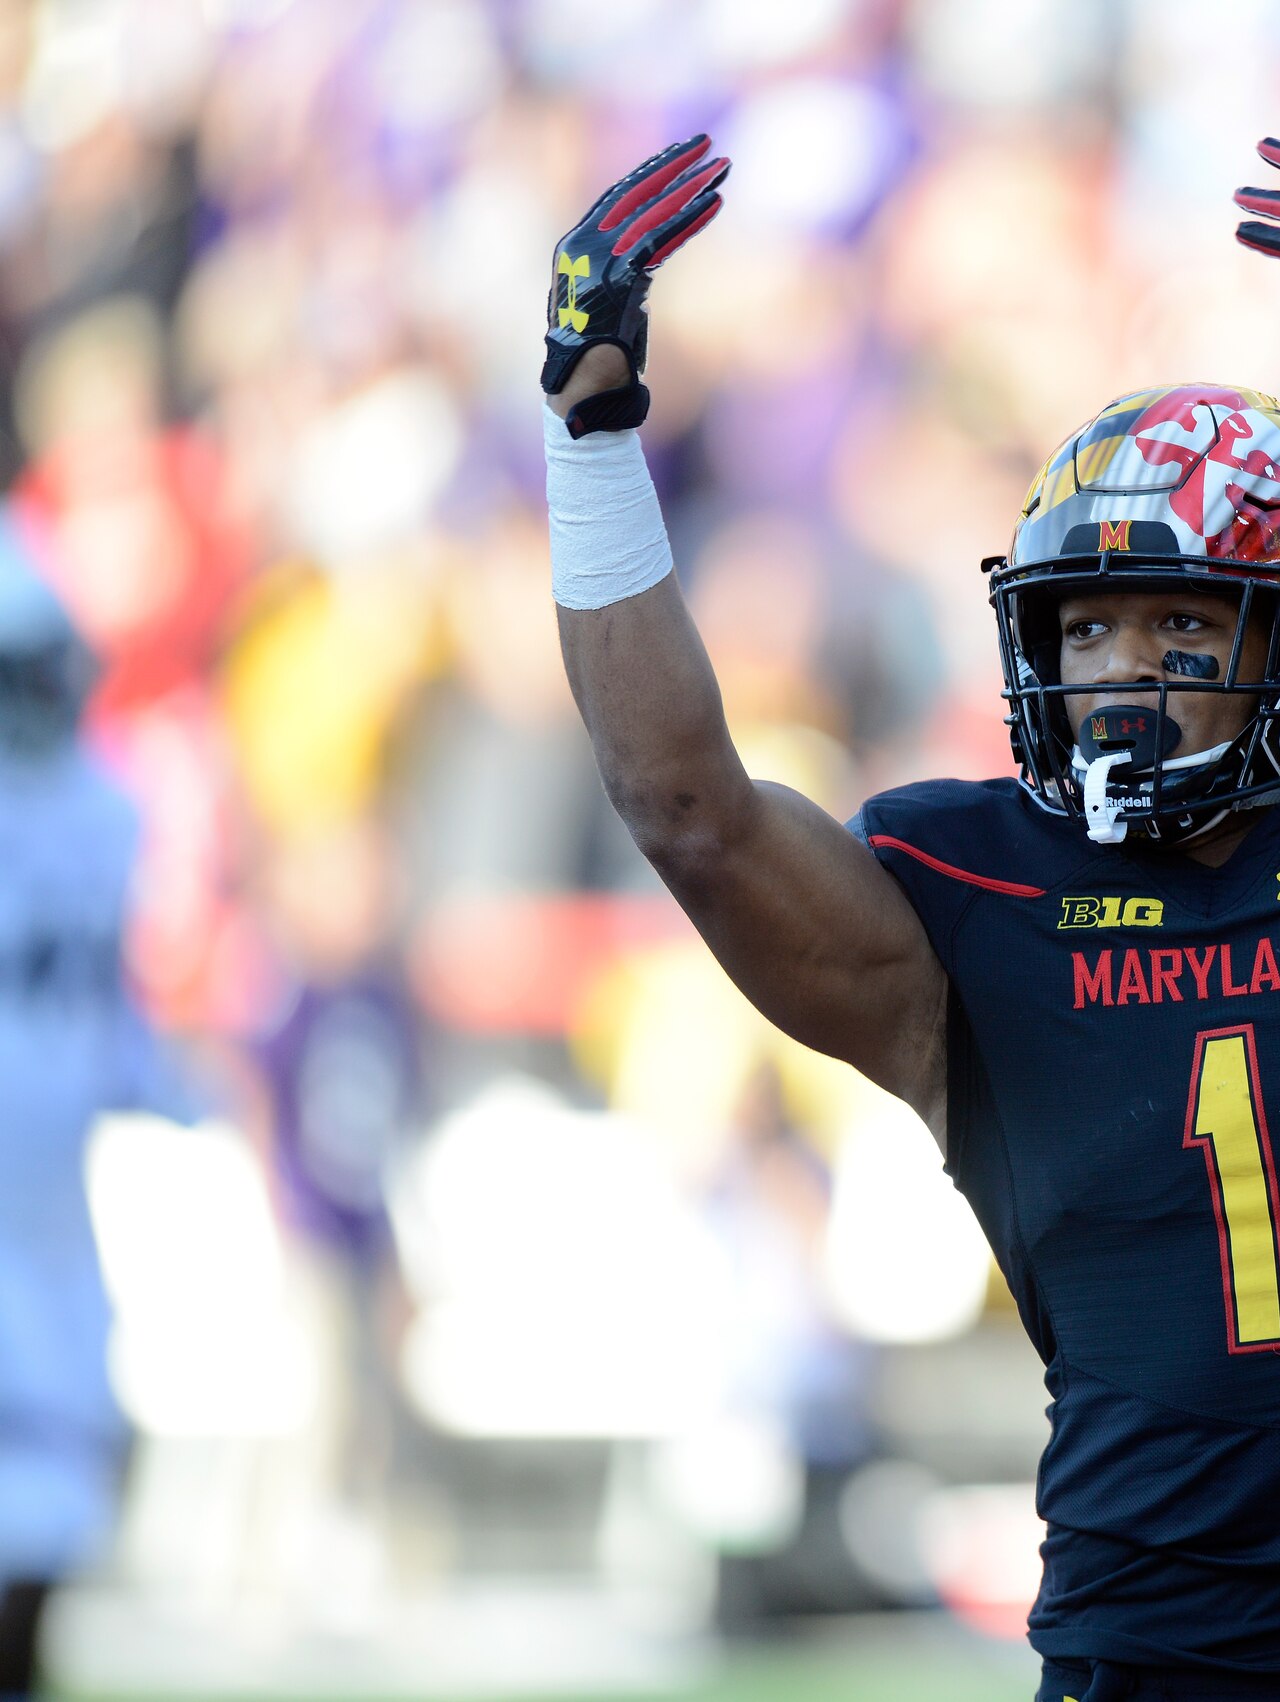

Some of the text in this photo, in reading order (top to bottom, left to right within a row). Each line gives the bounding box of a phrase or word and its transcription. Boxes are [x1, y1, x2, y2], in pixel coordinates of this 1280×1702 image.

[1098, 519, 1132, 551] M
[1091, 717, 1107, 739] M
[1106, 797, 1152, 808] Riddell
